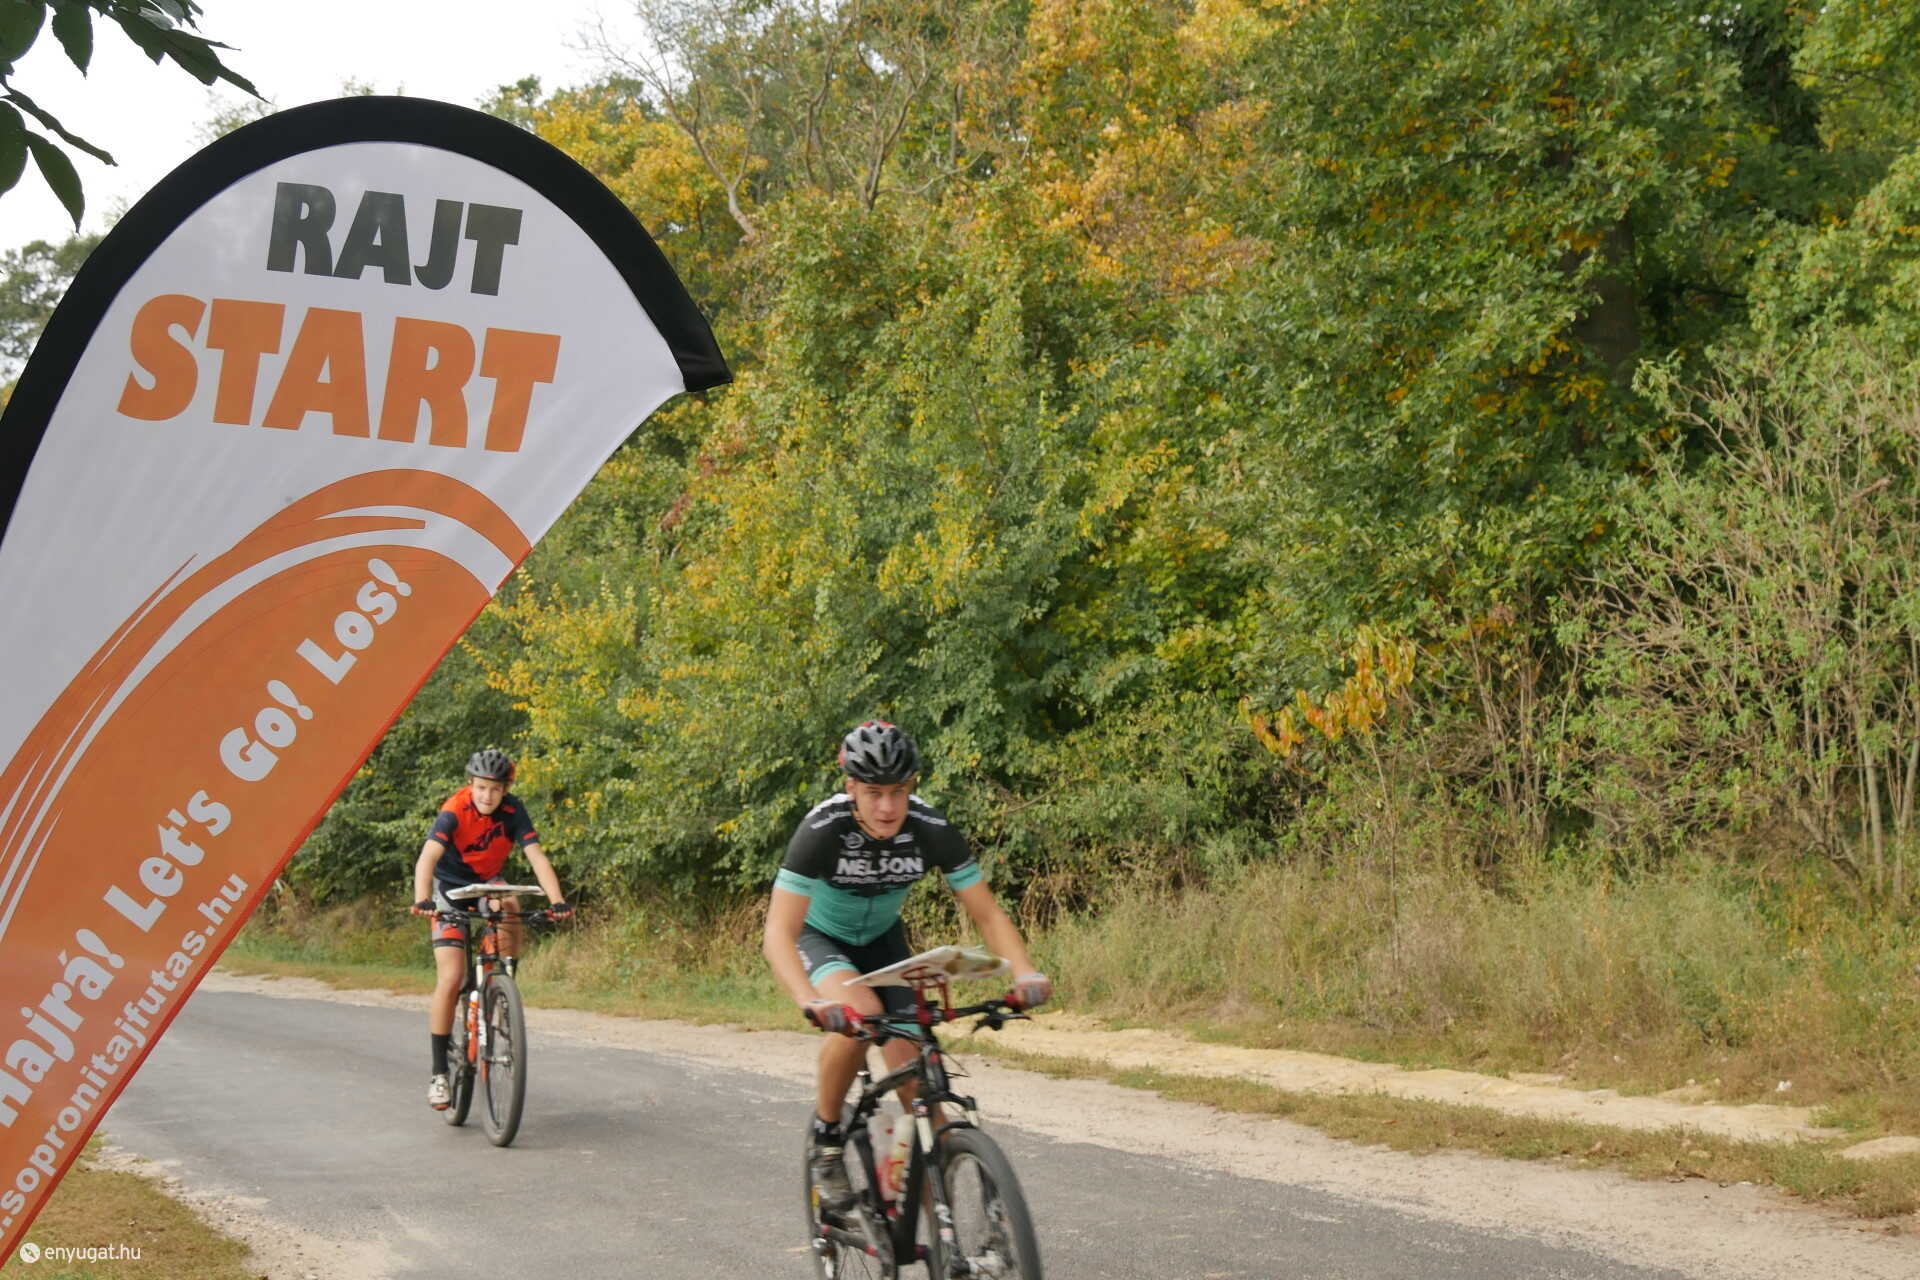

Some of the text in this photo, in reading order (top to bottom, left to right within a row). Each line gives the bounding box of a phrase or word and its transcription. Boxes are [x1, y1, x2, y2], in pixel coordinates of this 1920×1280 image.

[266, 182, 523, 296] RAJT
[117, 294, 561, 452] START
[103, 789, 231, 933] Let's
[219, 680, 313, 782] Go!
[296, 558, 412, 685] Los!
[836, 857, 924, 876] NELSON
[0, 873, 248, 1239] .sopronitajfutas.hu
